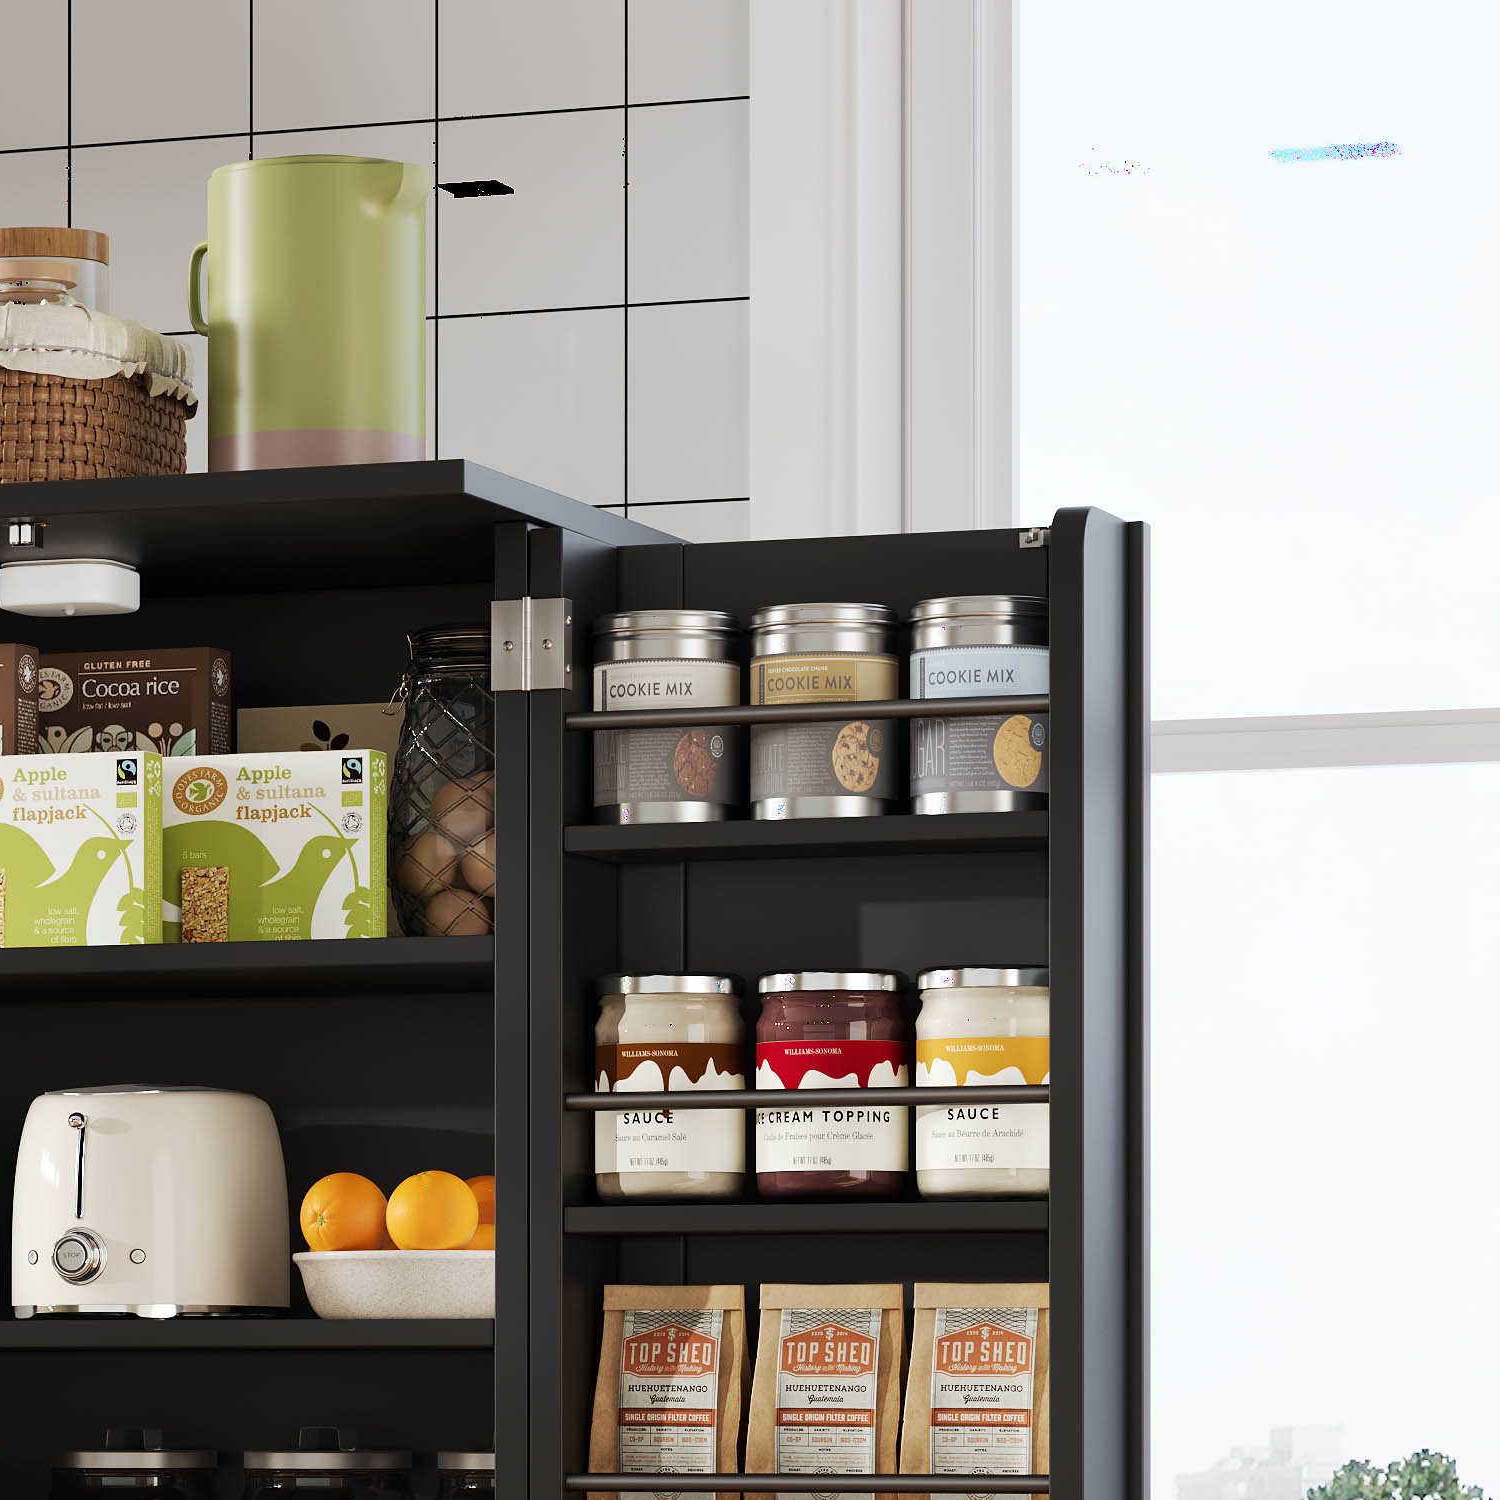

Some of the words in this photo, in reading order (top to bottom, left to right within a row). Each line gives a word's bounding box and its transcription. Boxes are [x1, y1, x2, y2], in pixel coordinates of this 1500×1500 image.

[84, 660, 121, 670] GLUTEN
[126, 659, 151, 668] FREE
[767, 676, 818, 692] COOKIE
[824, 674, 852, 689] MIX
[928, 669, 981, 686] COOKIE
[987, 668, 1014, 683] MIX
[82, 678, 141, 698] Cocoa
[146, 676, 179, 695] rice
[610, 682, 660, 698] COOKIE
[666, 681, 692, 695] MIX
[13, 768, 67, 785] Apple
[236, 765, 291, 783] Apple
[13, 788, 27, 801] &
[32, 785, 99, 801] sultana
[236, 787, 250, 800] &
[256, 785, 325, 800] sultana
[13, 804, 86, 824] flapjack
[236, 802, 311, 822] flapjack
[622, 1049, 678, 1058] WILLIAMS-SONOMA
[784, 1047, 842, 1056] WILLIAMS-SONOMA
[946, 1044, 1004, 1053] WILLIAMS-SONOMA
[623, 1111, 674, 1125] SAUCE
[768, 1111, 813, 1123] CREAM
[822, 1110, 890, 1123] TOPPING
[947, 1108, 999, 1121] SAUCE
[629, 1342, 661, 1364] TOP
[667, 1342, 711, 1364] SHED
[787, 1341, 818, 1364] TOP
[824, 1341, 869, 1364] SHED
[941, 1341, 974, 1364] TOP
[980, 1341, 1025, 1364] SHED
[628, 1384, 708, 1393] HUEHUETENANGO
[785, 1384, 866, 1393] HUEHUETENANGO
[941, 1384, 1023, 1393] HUEHUETENANGO
[625, 1413, 646, 1422] SINGLE
[647, 1413, 666, 1422] ORIGIN
[668, 1413, 686, 1422] FILTER
[689, 1413, 709, 1422] COFFEE
